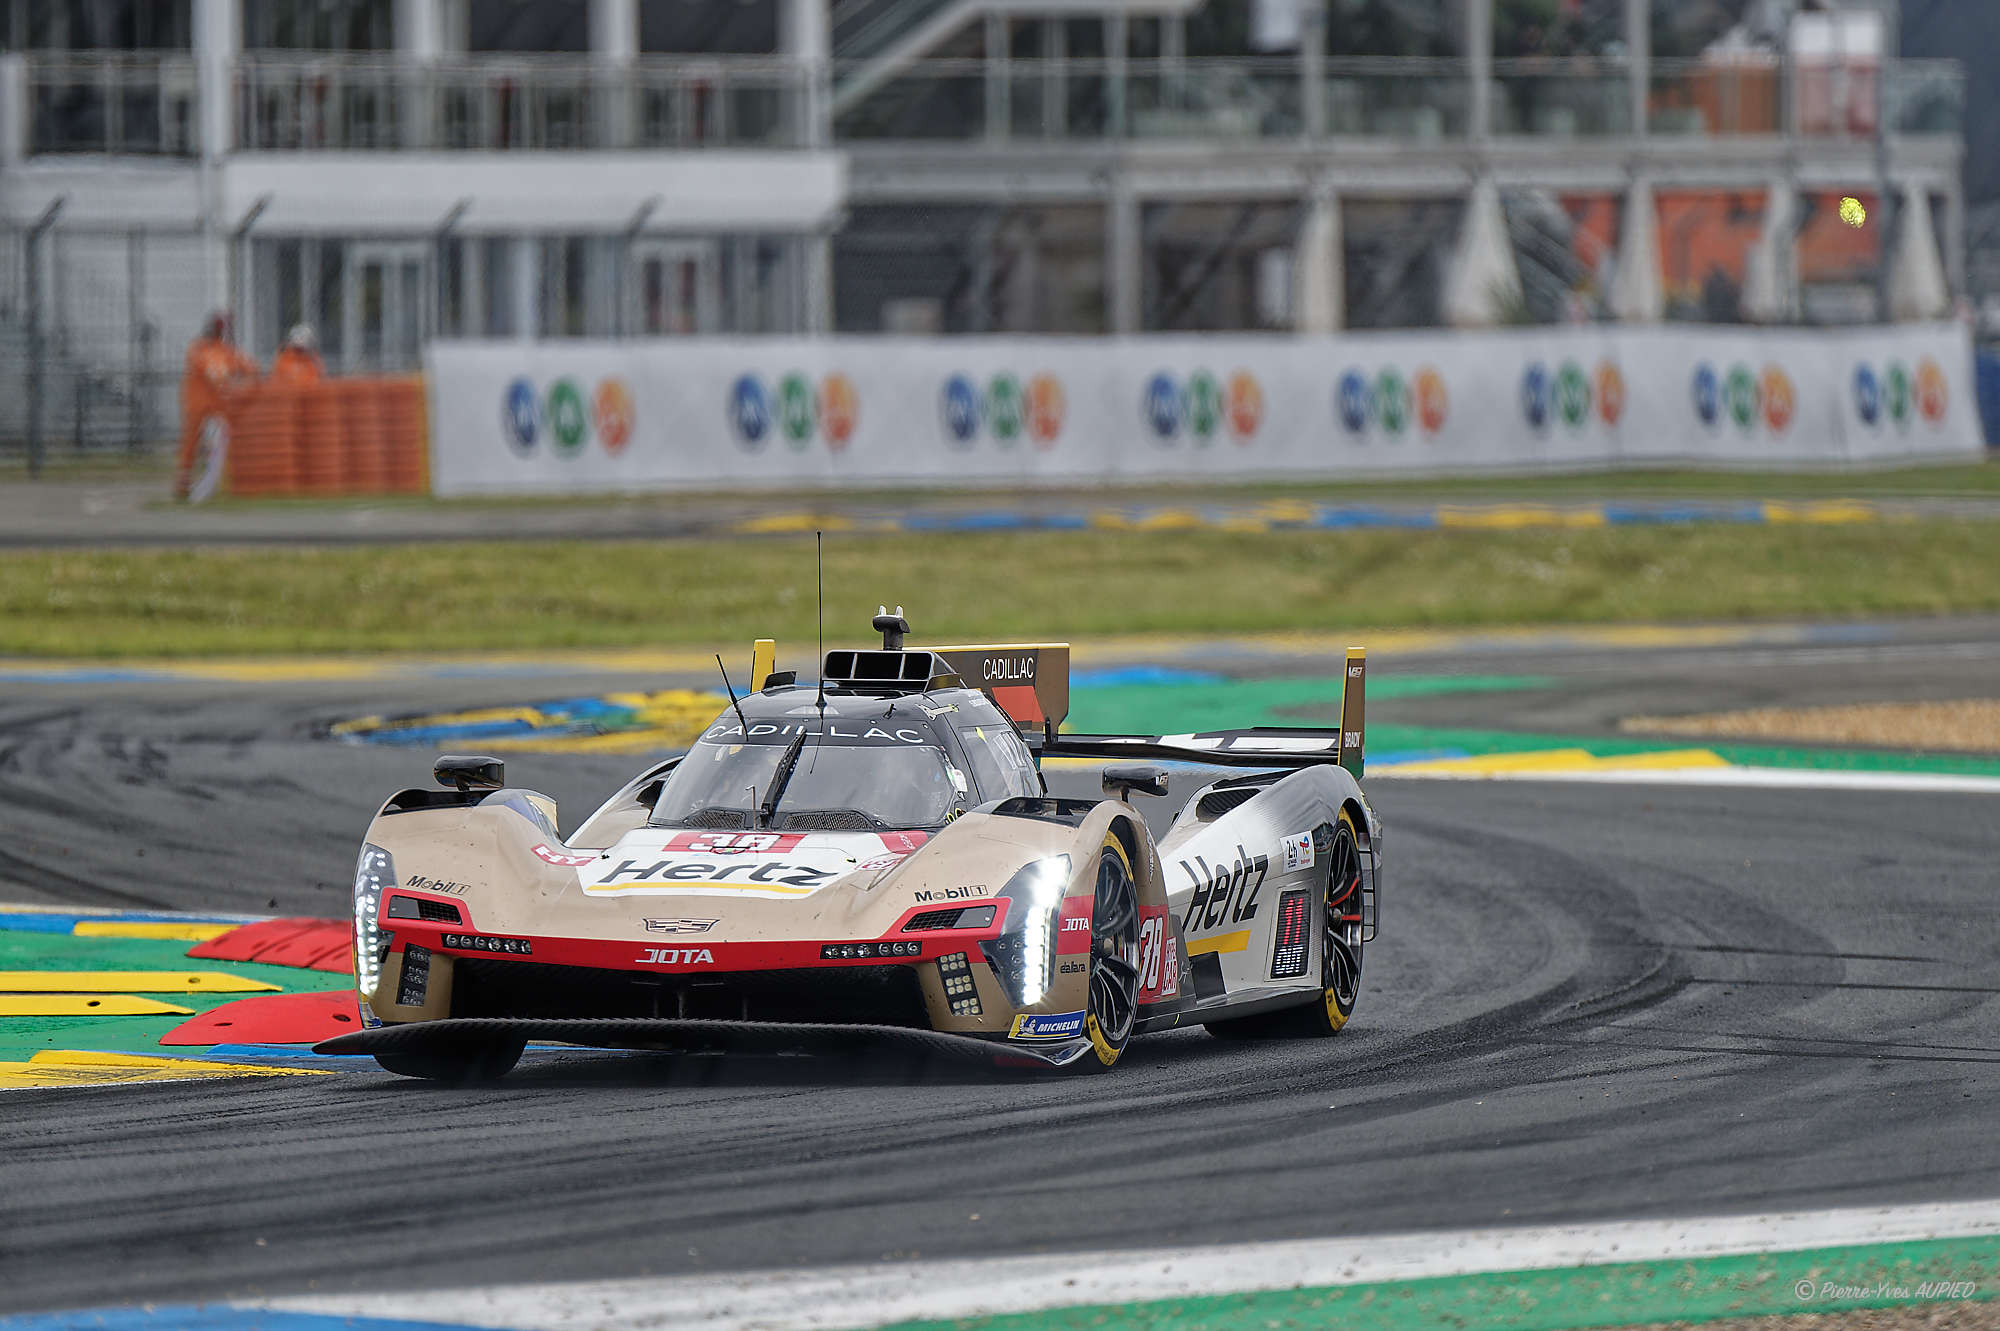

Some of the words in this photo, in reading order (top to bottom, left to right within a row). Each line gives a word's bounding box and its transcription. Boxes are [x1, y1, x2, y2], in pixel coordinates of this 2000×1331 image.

[983, 656, 1035, 681] CADILLAC
[704, 723, 925, 744] CADILLAC
[1344, 731, 1361, 748] BRADY
[597, 860, 839, 887] Hertz
[406, 875, 456, 893] Mobil
[1180, 844, 1269, 933] Hertz
[914, 887, 970, 902] Mobil
[1061, 917, 1090, 931] JOTA
[635, 949, 714, 964] JOTA
[1037, 1019, 1080, 1033] MICHELIN
